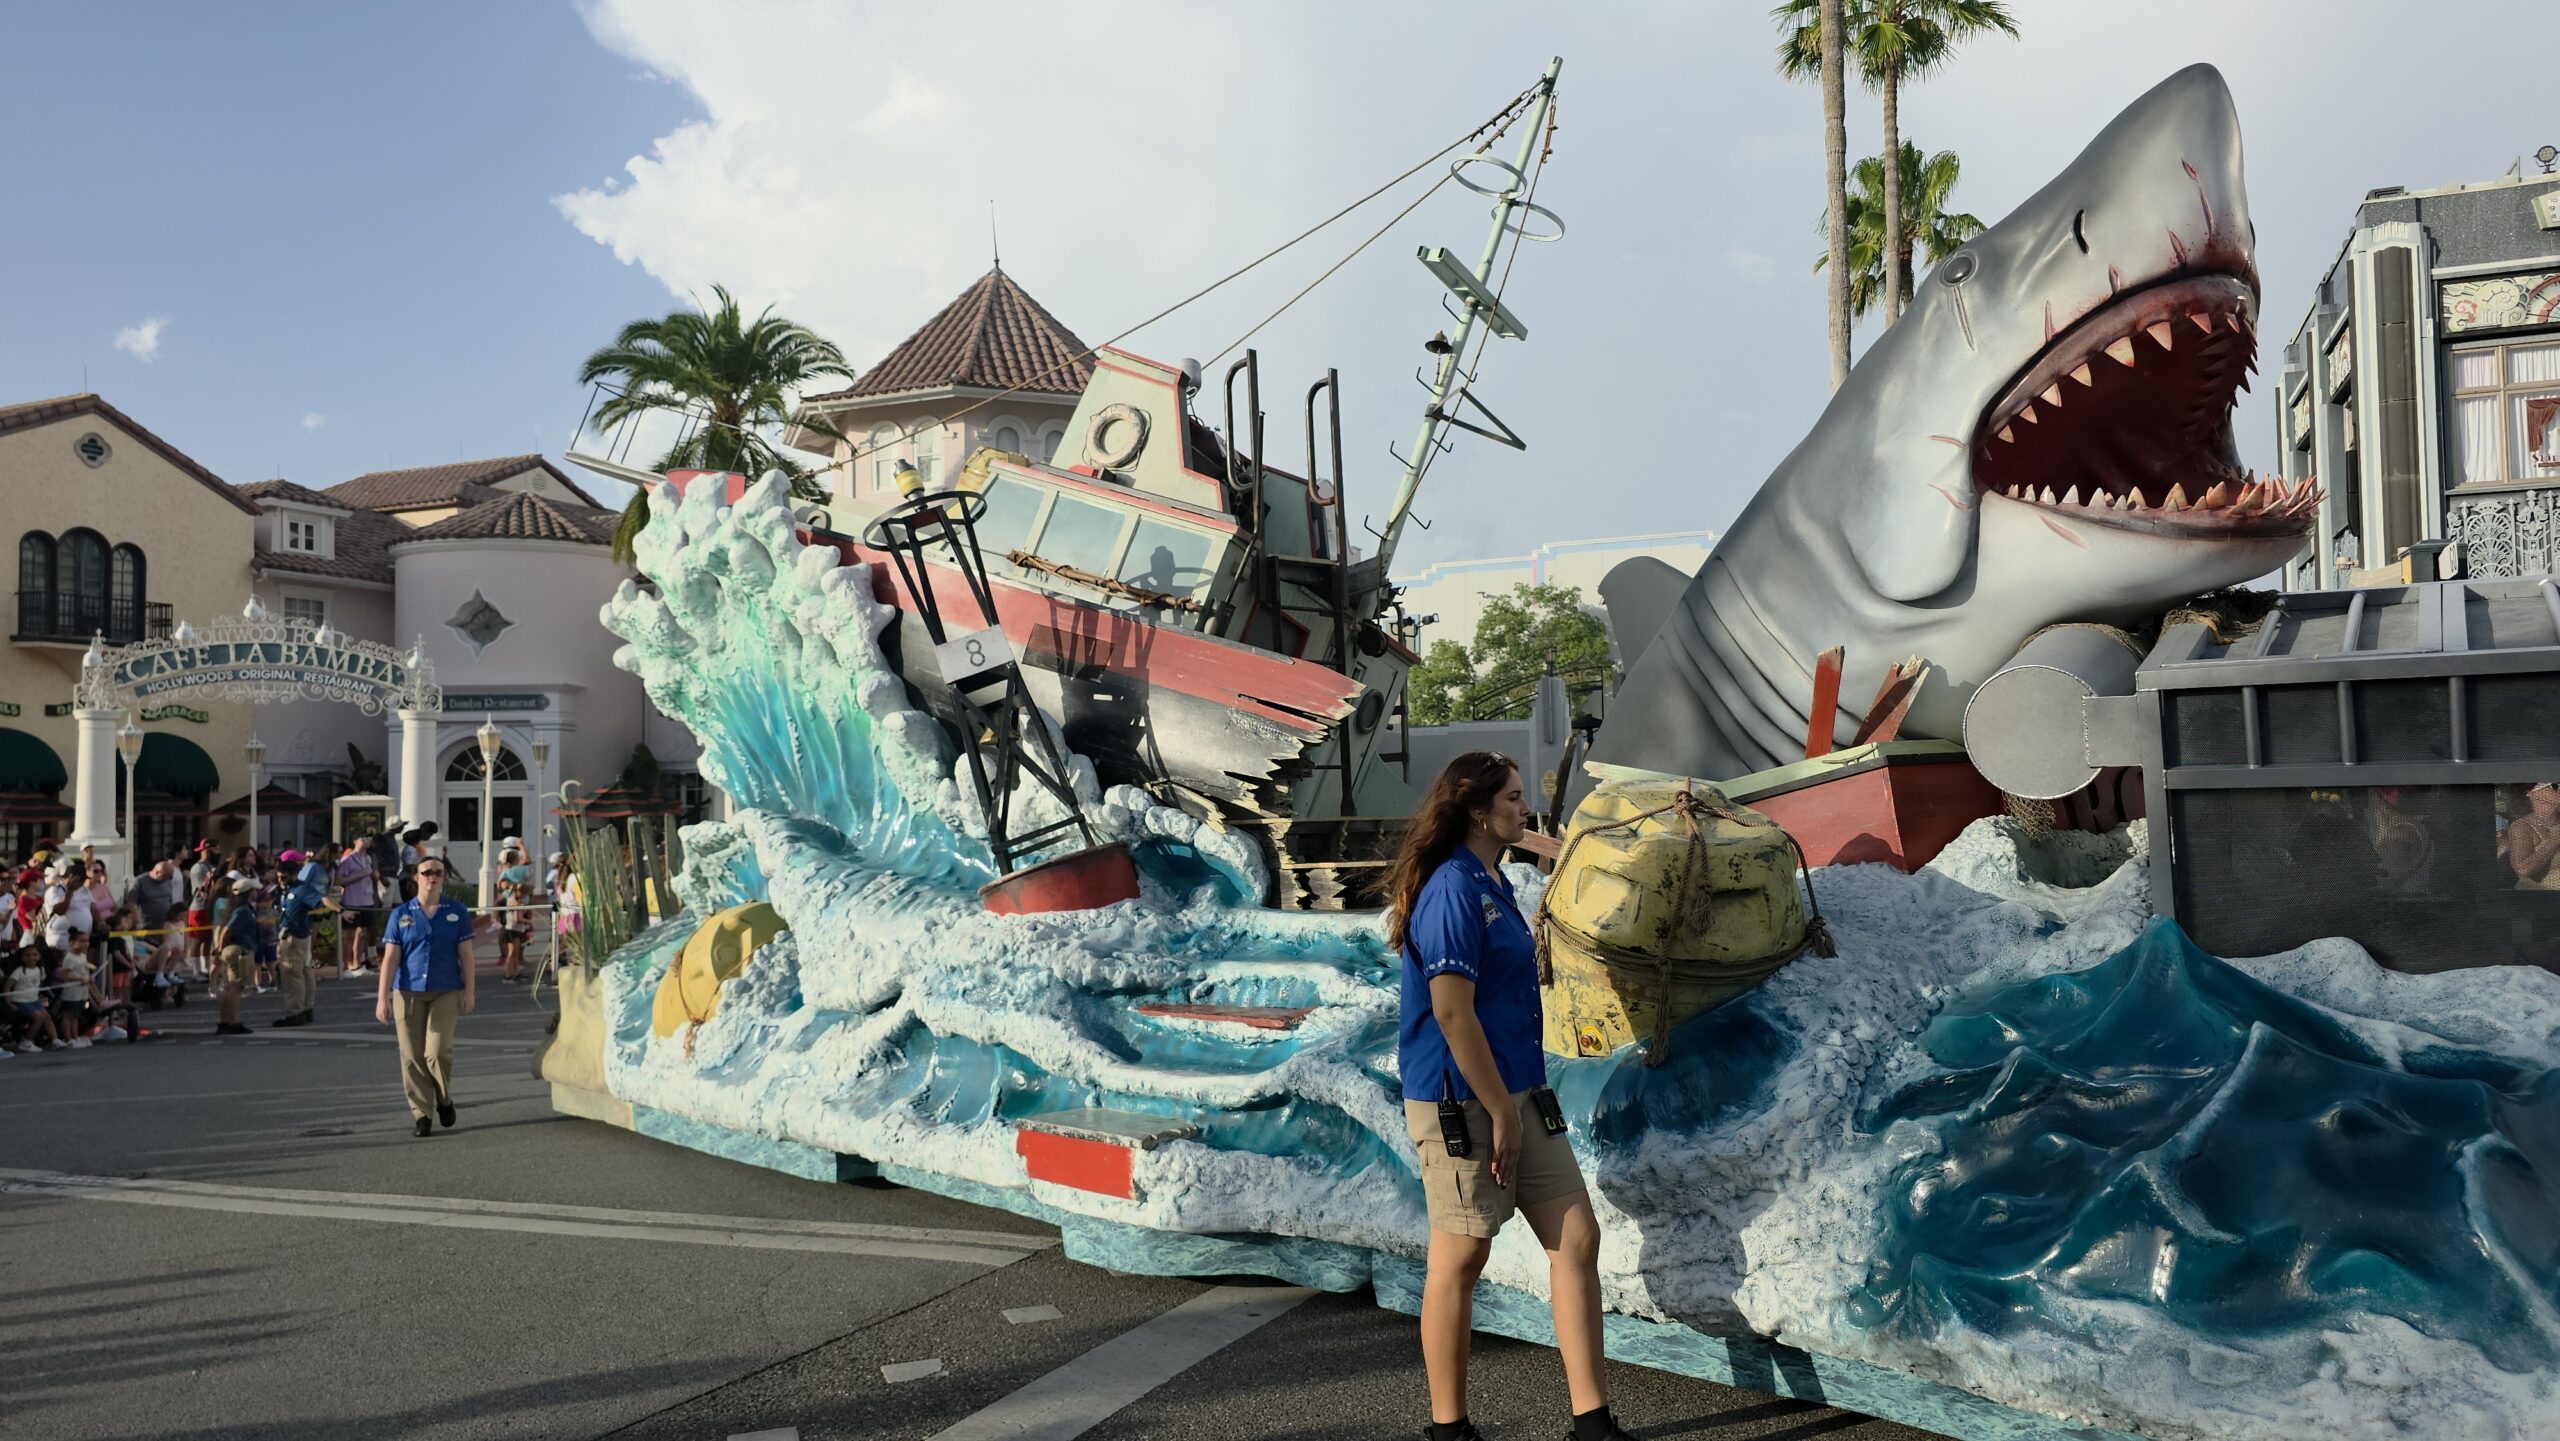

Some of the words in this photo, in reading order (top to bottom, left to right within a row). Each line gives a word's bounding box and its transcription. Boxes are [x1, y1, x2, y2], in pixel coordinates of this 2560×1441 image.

[228, 642, 268, 666] LA
[279, 643, 394, 684] BAMBA
[966, 640, 986, 667] 8
[239, 669, 298, 681] ORIGINAL
[303, 672, 375, 694] RESTAURANT
